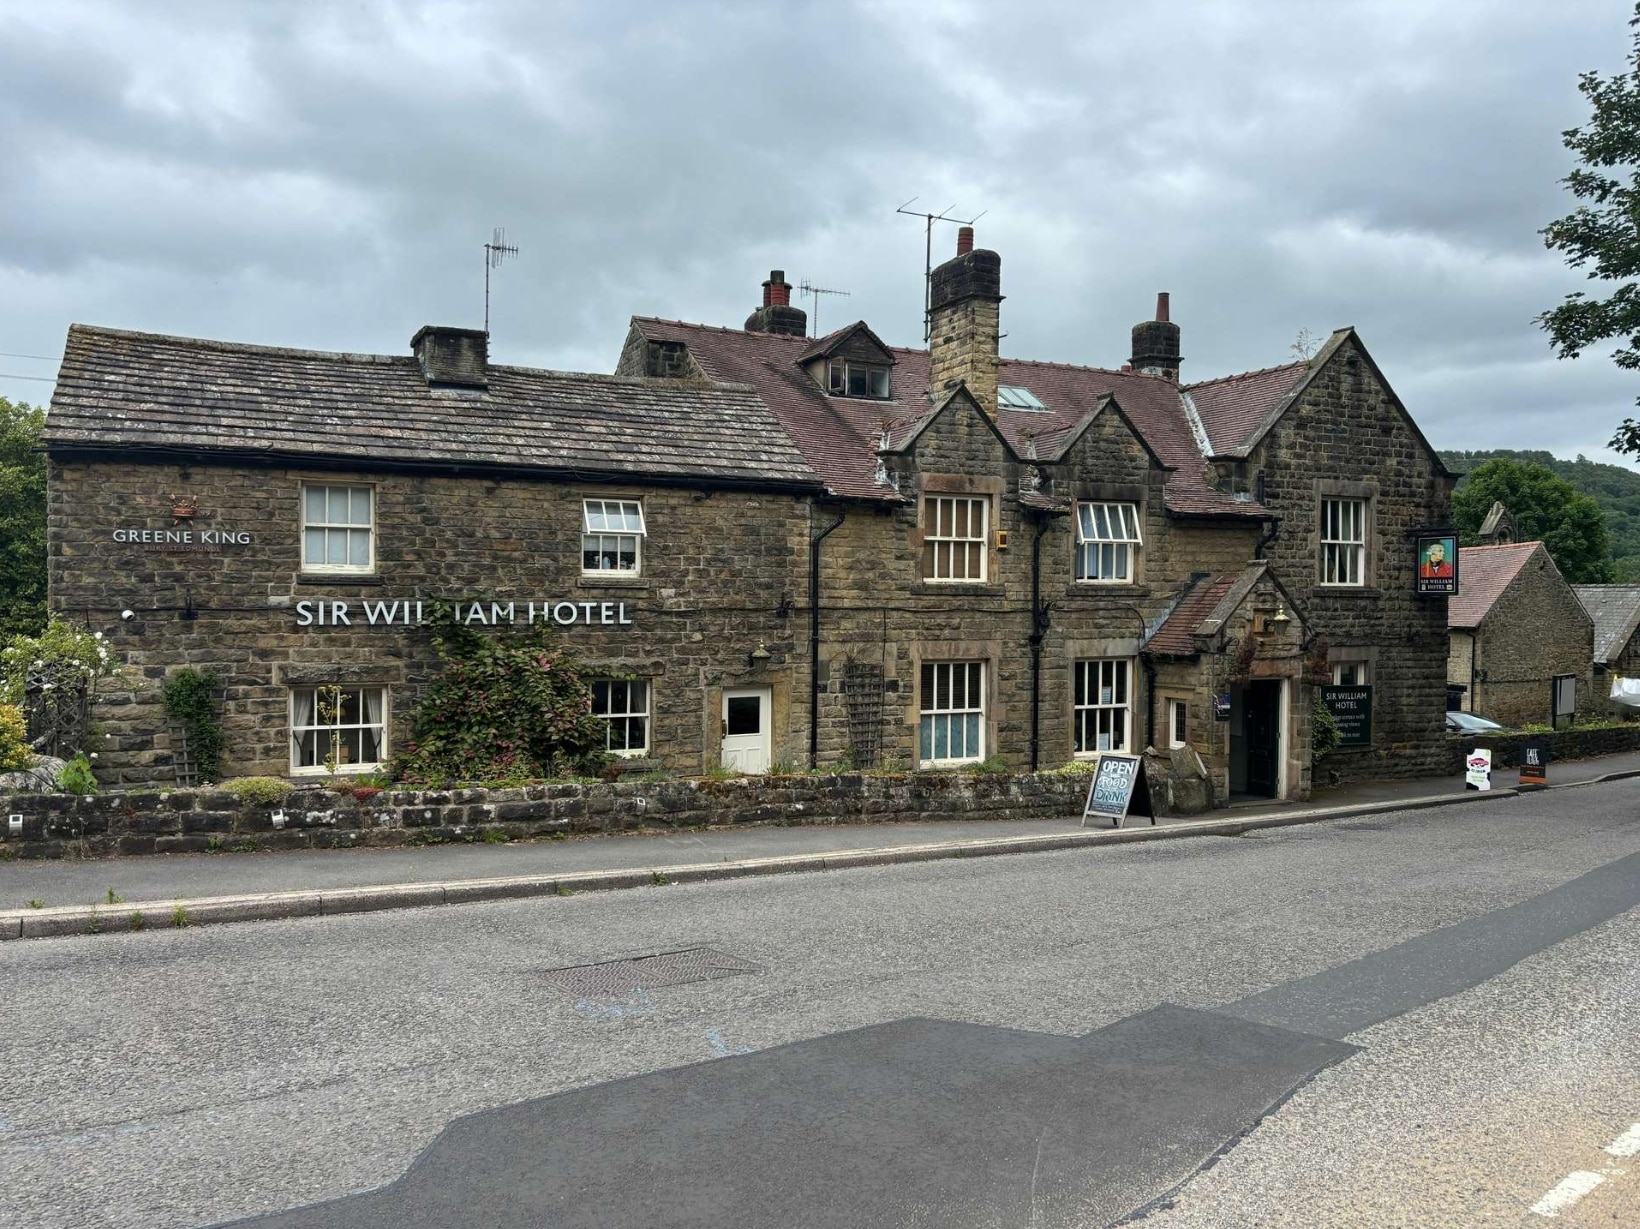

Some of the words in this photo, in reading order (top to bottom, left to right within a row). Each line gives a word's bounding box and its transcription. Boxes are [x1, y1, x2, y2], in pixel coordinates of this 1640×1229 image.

[112, 529, 193, 543] GREENE
[201, 531, 250, 544] KING
[296, 600, 351, 626] SIR
[362, 600, 515, 625] WILIAM
[528, 601, 632, 625] HOTEL
[1326, 692, 1337, 700] SIR
[1338, 692, 1367, 700] WILLIAM
[1335, 701, 1358, 709] HOTEL
[1103, 760, 1135, 775] OPEN
[1098, 776, 1128, 789] FOOD
[1096, 788, 1128, 802] DRINK
